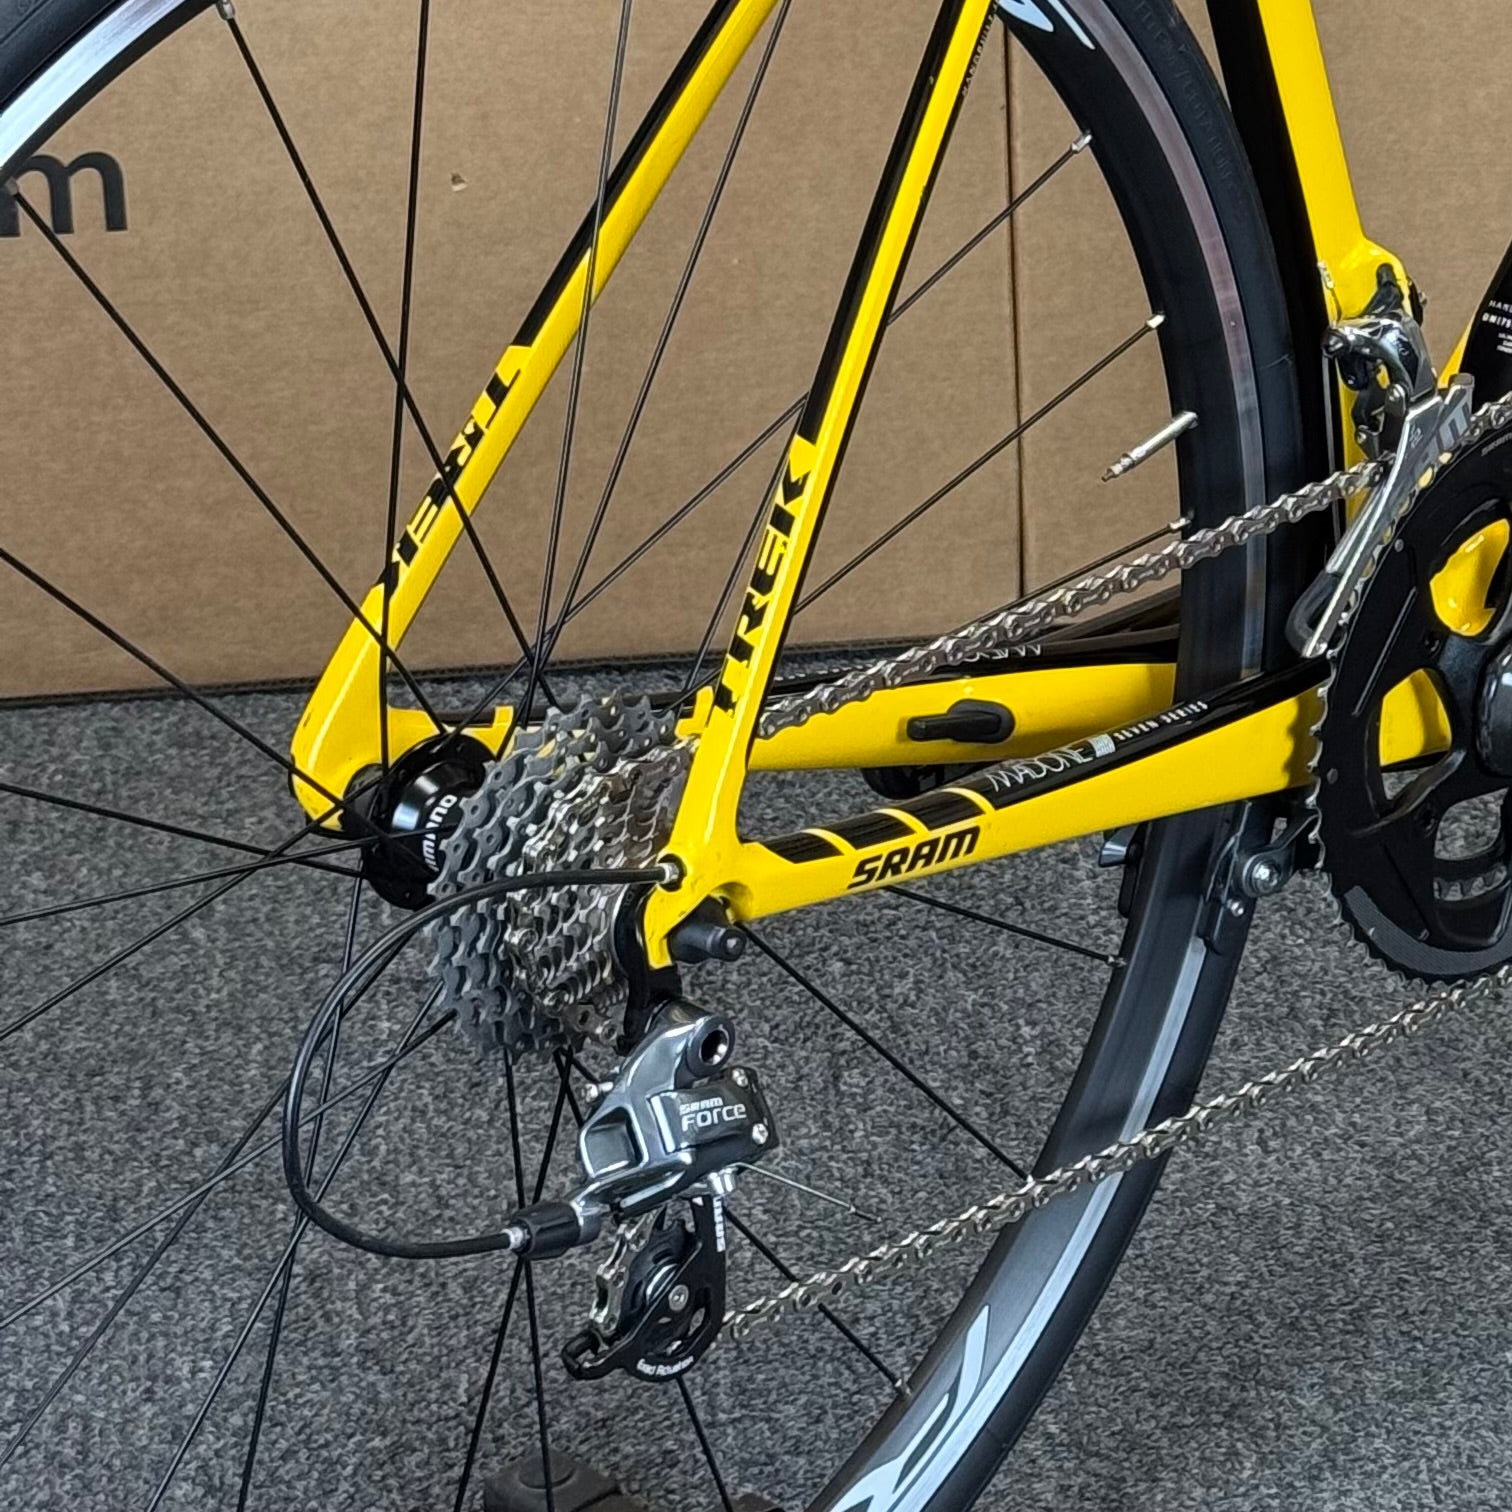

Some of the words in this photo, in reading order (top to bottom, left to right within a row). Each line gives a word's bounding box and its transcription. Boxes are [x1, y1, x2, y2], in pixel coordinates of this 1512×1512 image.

[713, 468, 813, 719] TREK
[984, 745, 1095, 793] MADONE
[1112, 719, 1160, 741] SEVEN
[1160, 699, 1209, 725] SERIES
[847, 825, 982, 890] SRAM
[681, 1103, 748, 1132] Force
